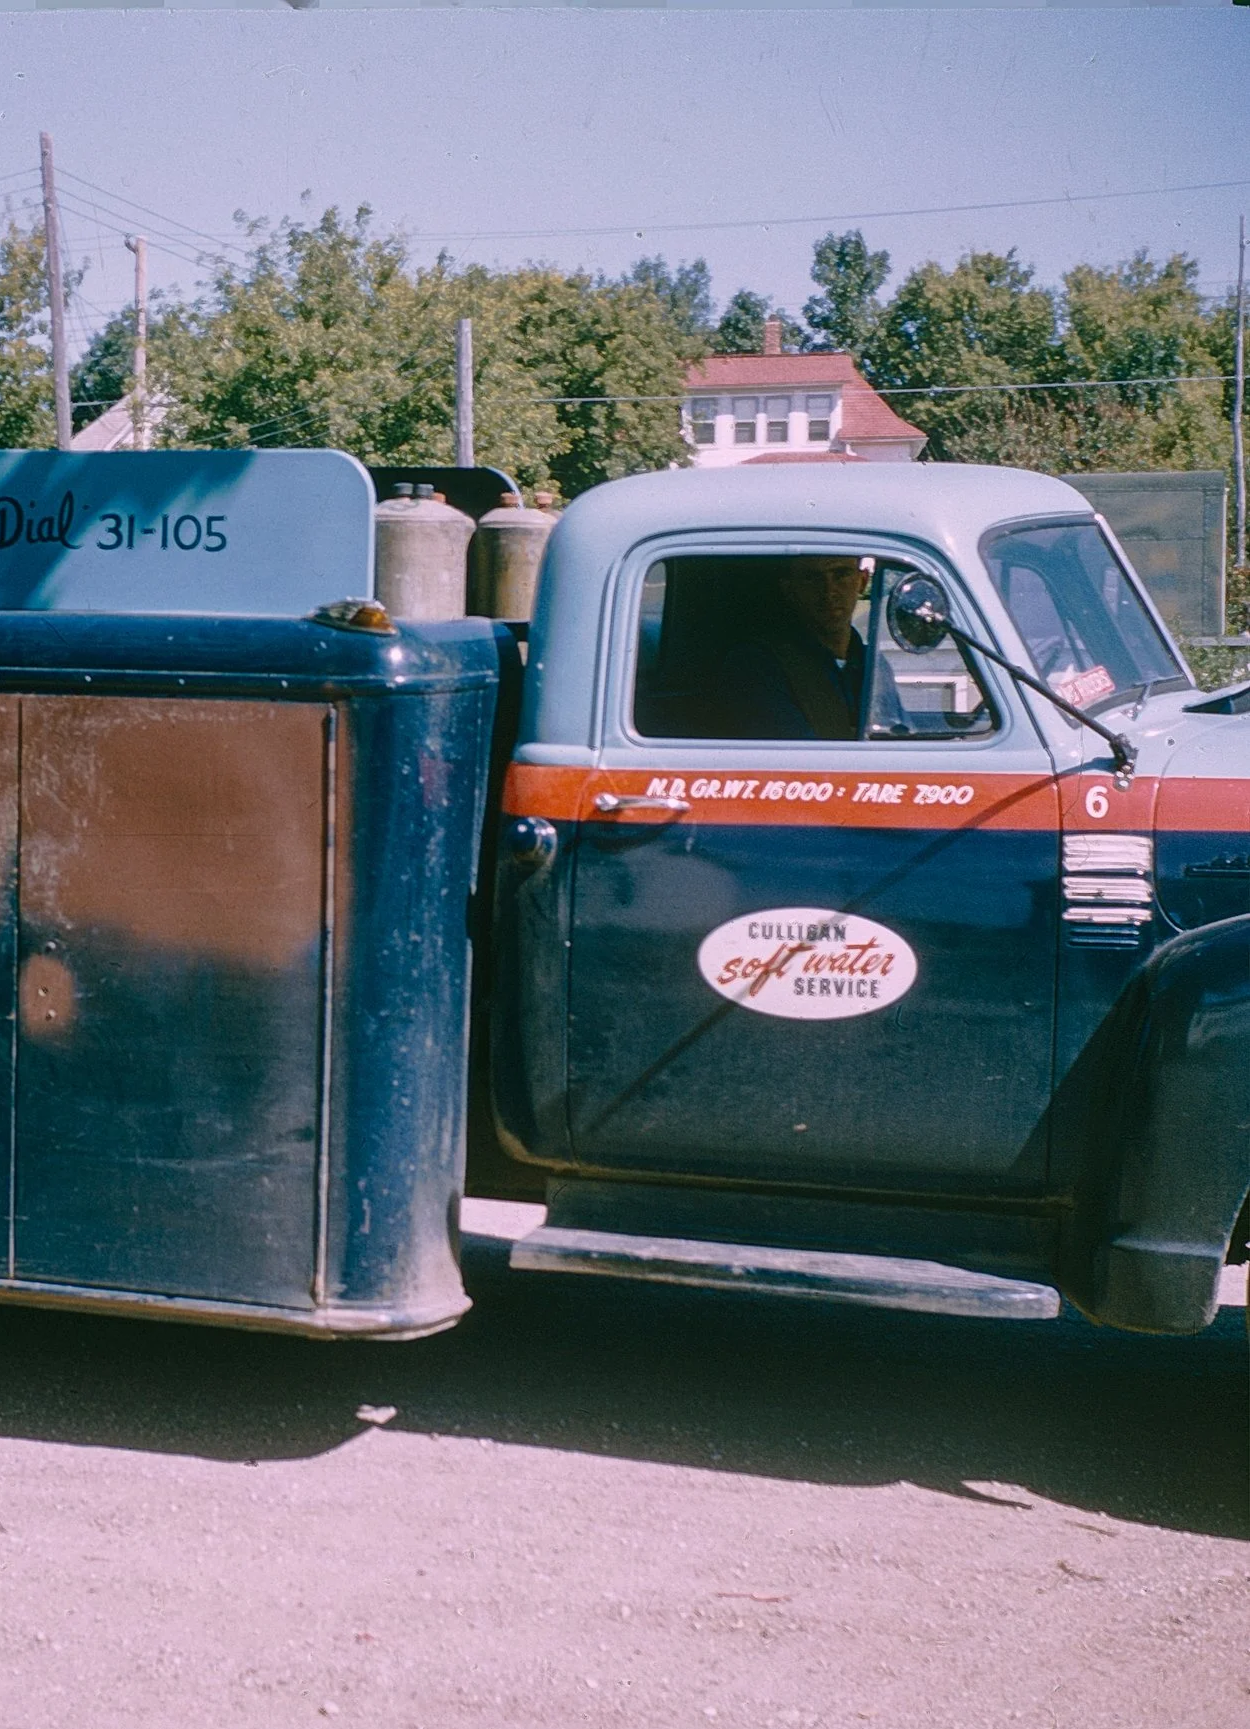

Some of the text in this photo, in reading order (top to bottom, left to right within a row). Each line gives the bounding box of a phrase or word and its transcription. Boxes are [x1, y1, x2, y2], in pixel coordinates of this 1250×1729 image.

[96, 513, 227, 552] 31-105
[852, 783, 908, 804] TARE
[1085, 785, 1109, 819] 6
[748, 920, 847, 943] CULLIGAN
[716, 935, 896, 997] soft water
[793, 976, 881, 999] SERVICE
